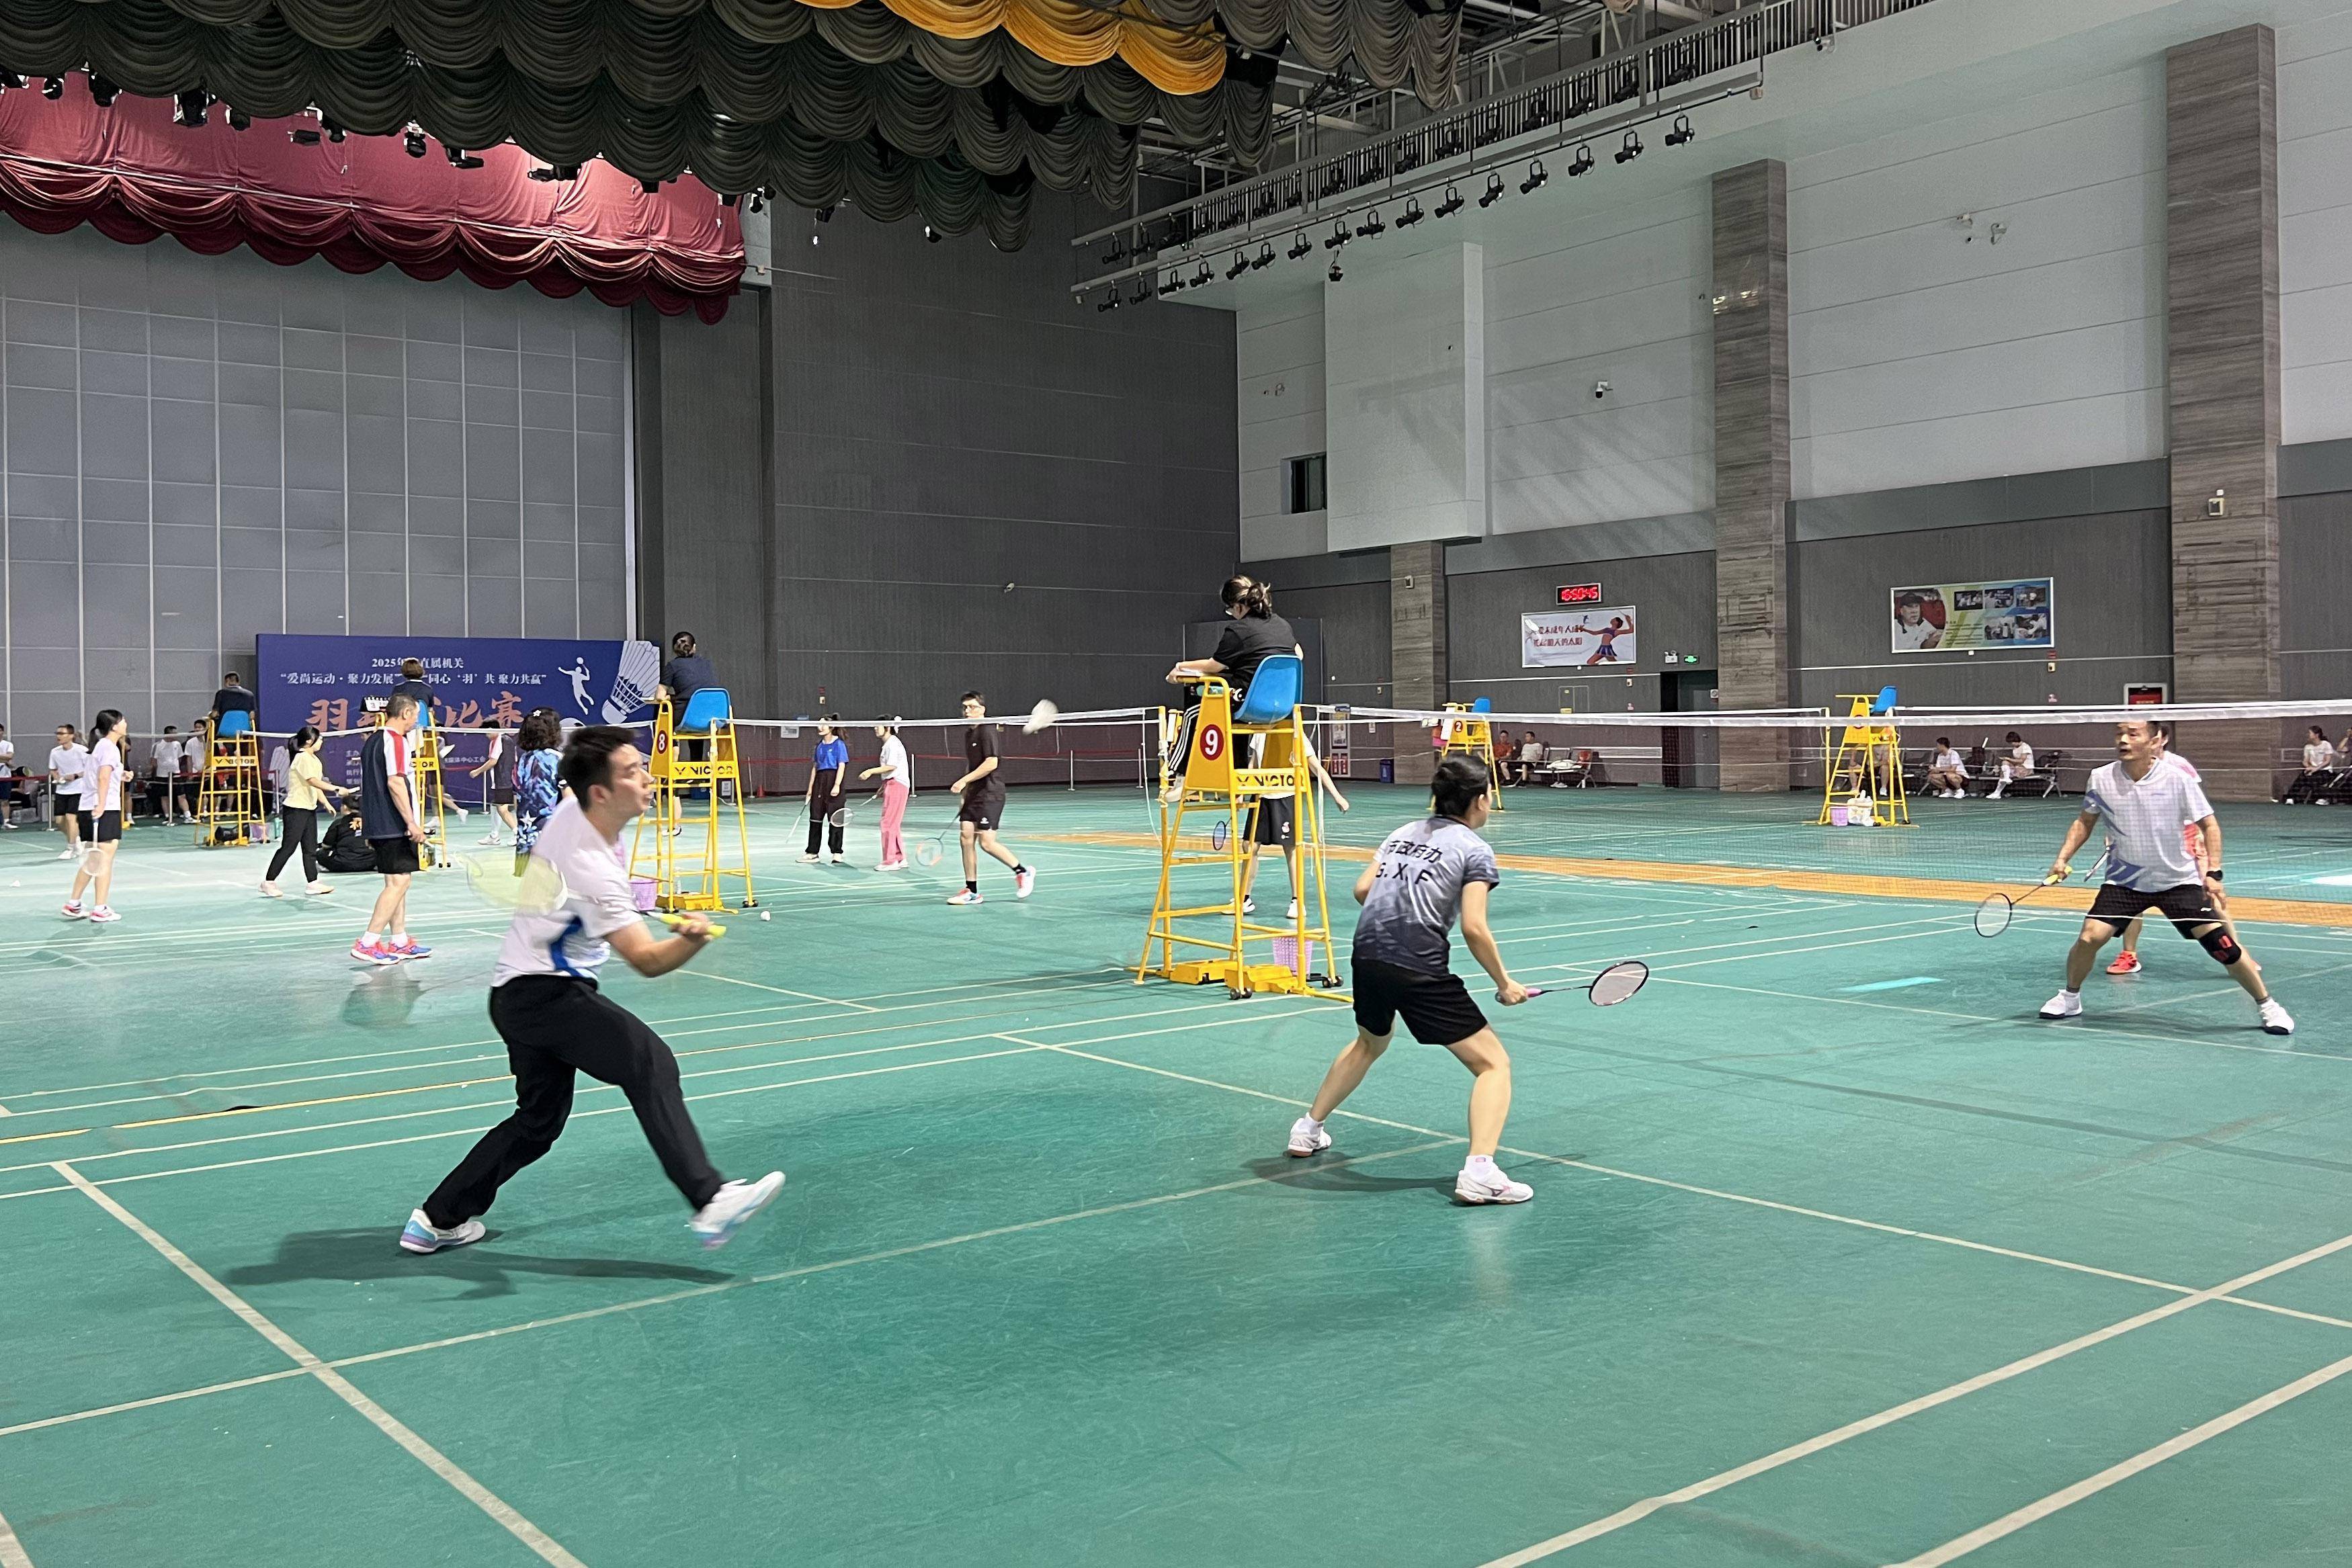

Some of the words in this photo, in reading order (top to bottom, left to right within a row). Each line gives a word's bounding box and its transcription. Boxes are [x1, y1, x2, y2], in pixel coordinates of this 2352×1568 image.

[1456, 722, 1462, 732] 2
[659, 733, 665, 751] 8
[1205, 730, 1218, 755] 9
[689, 765, 733, 775] VICOR
[1254, 775, 1304, 786] VICTO
